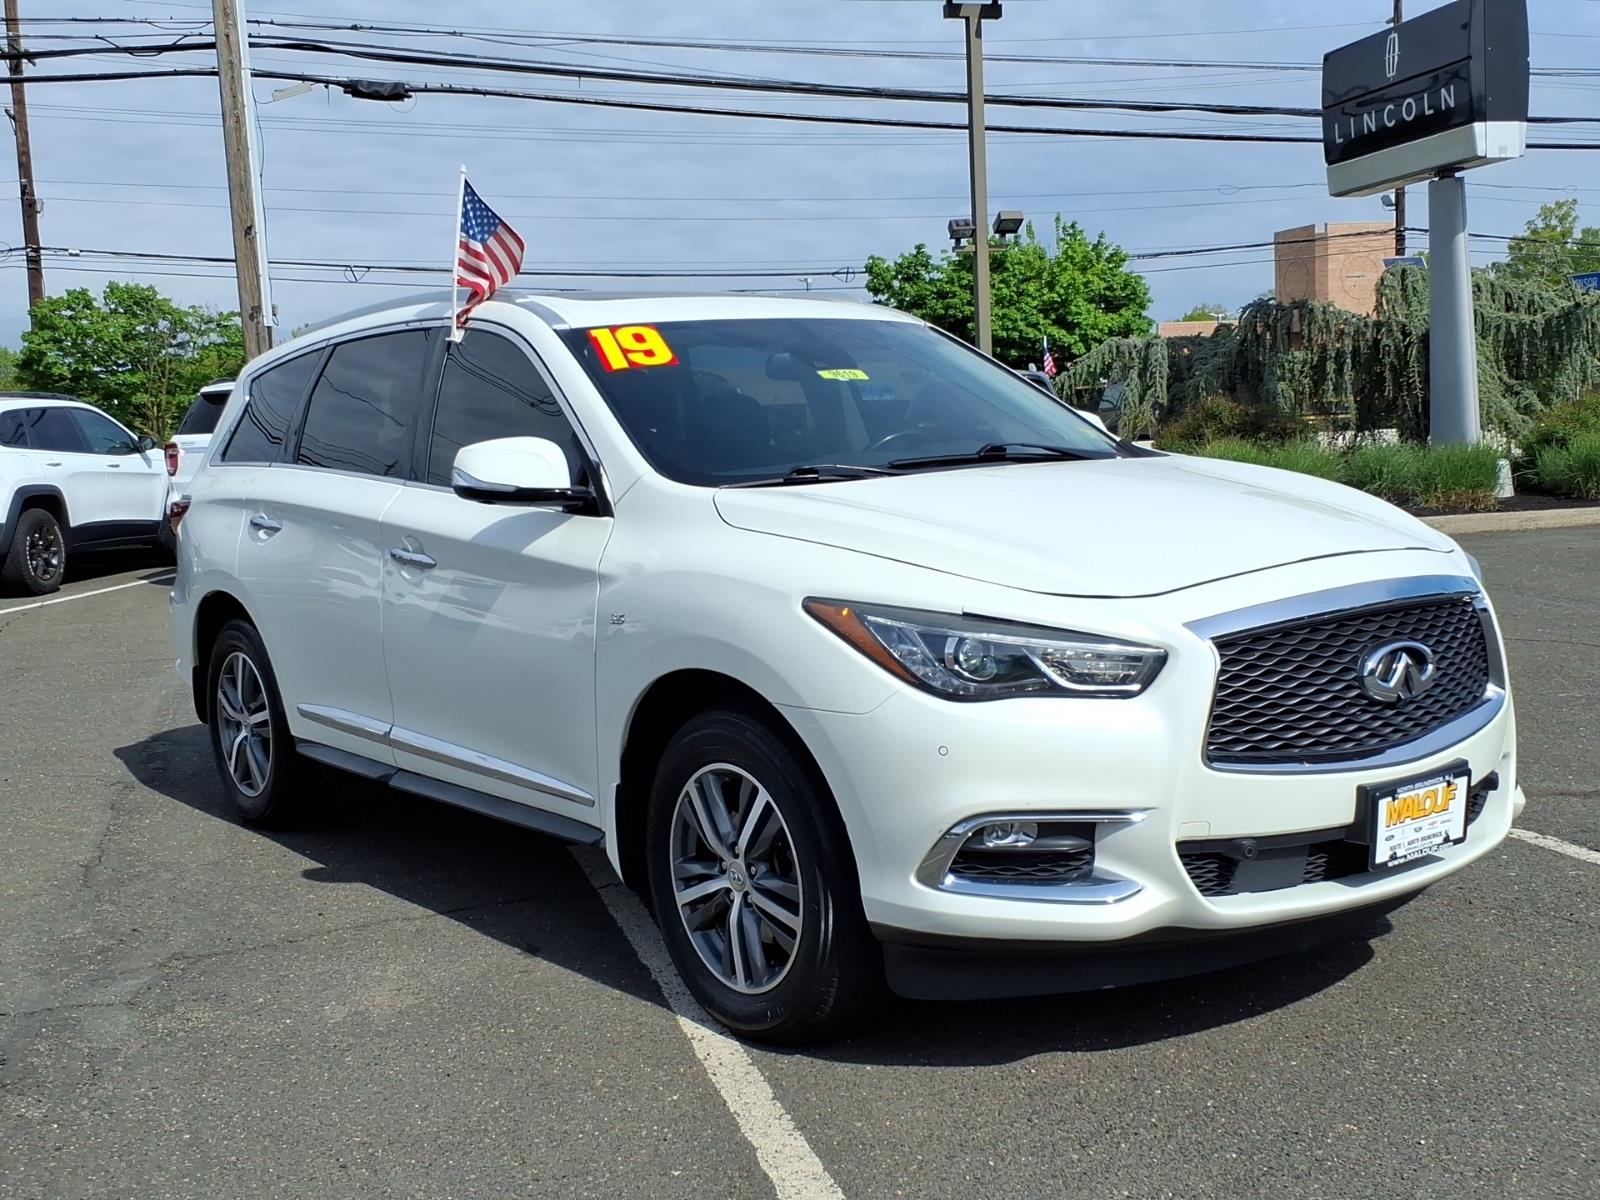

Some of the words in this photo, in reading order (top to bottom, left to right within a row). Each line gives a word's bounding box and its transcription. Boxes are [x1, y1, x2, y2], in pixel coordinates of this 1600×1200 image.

[1335, 85, 1455, 144] LINCOLN
[589, 326, 674, 371] 19
[1385, 783, 1458, 828] MALOUF
